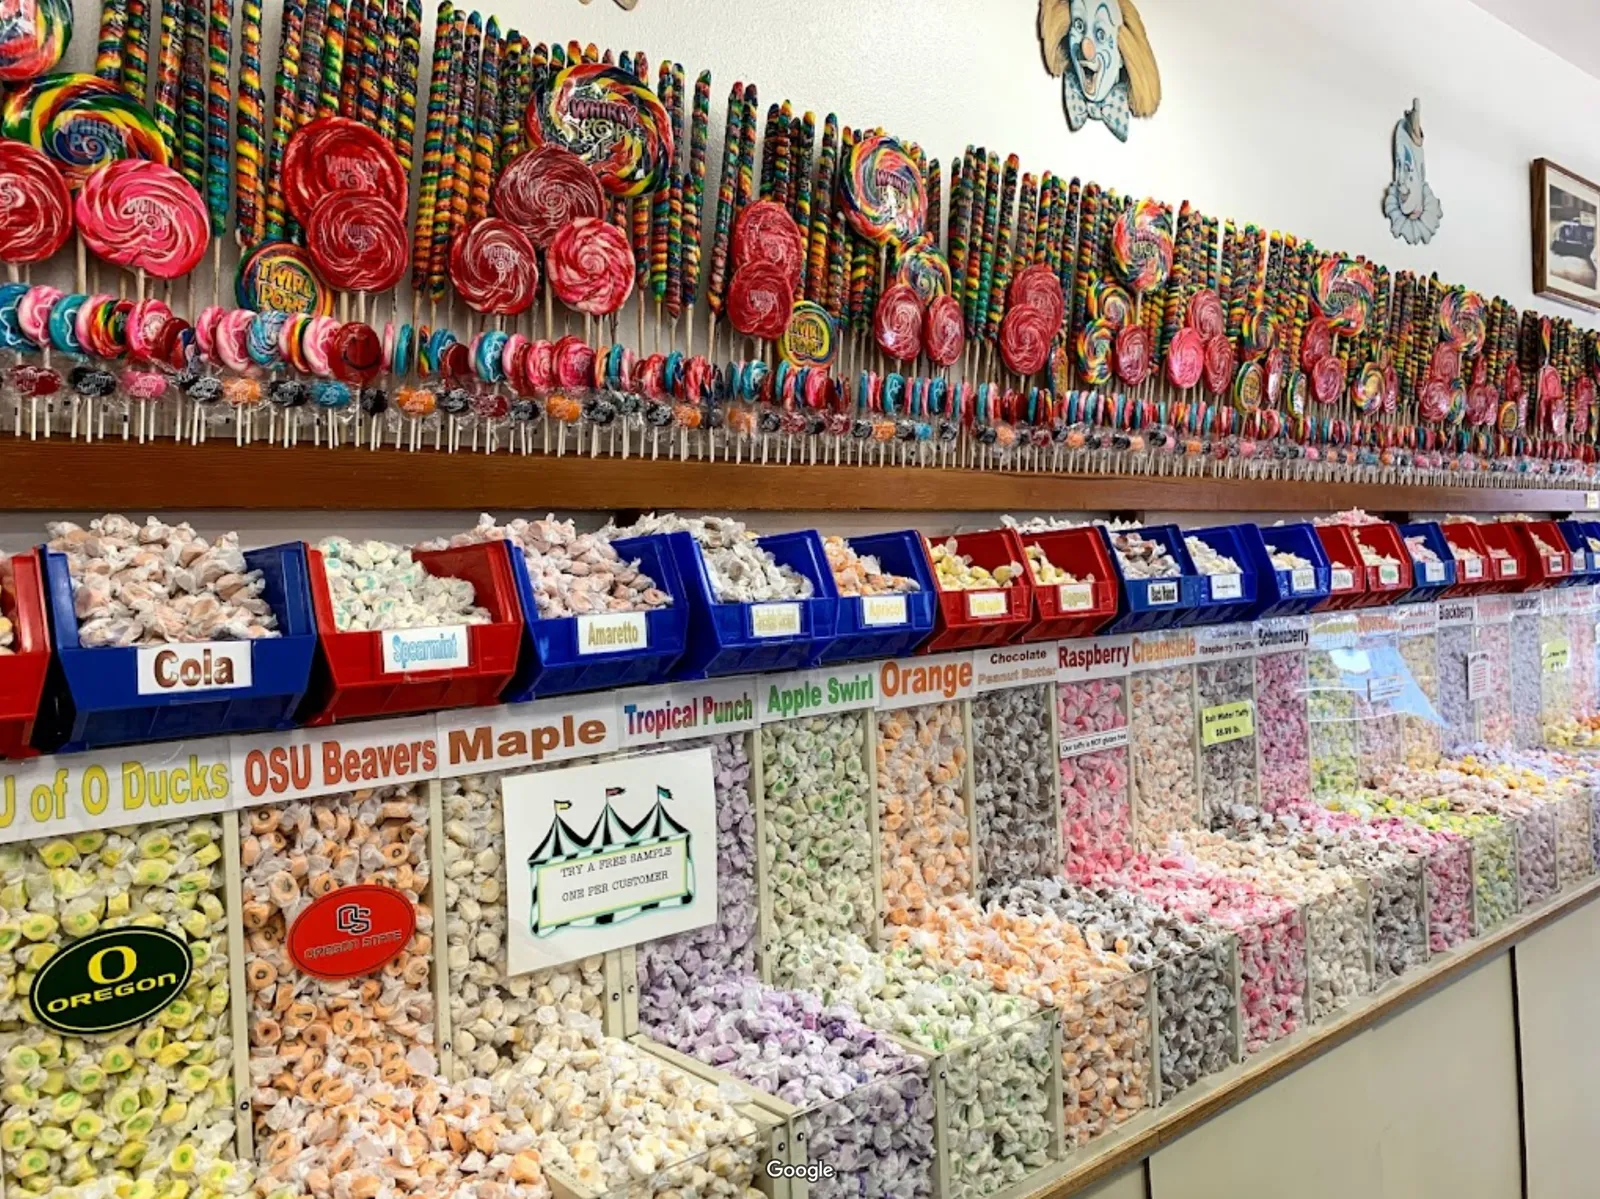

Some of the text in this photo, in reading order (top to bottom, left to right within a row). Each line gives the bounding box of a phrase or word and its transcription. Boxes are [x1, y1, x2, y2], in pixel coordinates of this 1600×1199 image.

[567, 97, 637, 131] WHIRLY
[258, 256, 313, 300] TWIRL
[1438, 603, 1474, 621] Blackberry
[392, 633, 458, 668] Spearmint
[588, 620, 639, 647] Amaretto
[1131, 632, 1196, 664] Creamsicle
[1200, 643, 1233, 656] Raspberry
[153, 648, 235, 689] Cola
[989, 649, 1047, 665] Chocolate
[1058, 643, 1130, 672] Raspberry
[879, 660, 973, 699] Orange
[977, 665, 1058, 686] Peanut Butter
[767, 673, 874, 718] Apple Swirl
[624, 691, 753, 739] Tropical Punch
[448, 715, 607, 765] Maple
[1062, 744, 1073, 752] Our
[1091, 737, 1101, 746] NOT
[1102, 734, 1117, 746] gluten
[245, 740, 437, 797] OSU Beavers
[30, 768, 69, 822] of
[81, 764, 109, 816] O
[122, 755, 230, 811] Ducks
[560, 845, 673, 878] TRY A FREE SAMPLE
[561, 869, 669, 902] ONE PER CUSTOMER
[304, 928, 403, 960] OREGON STATE
[88, 944, 138, 985] O
[47, 972, 177, 1013] OREGON
